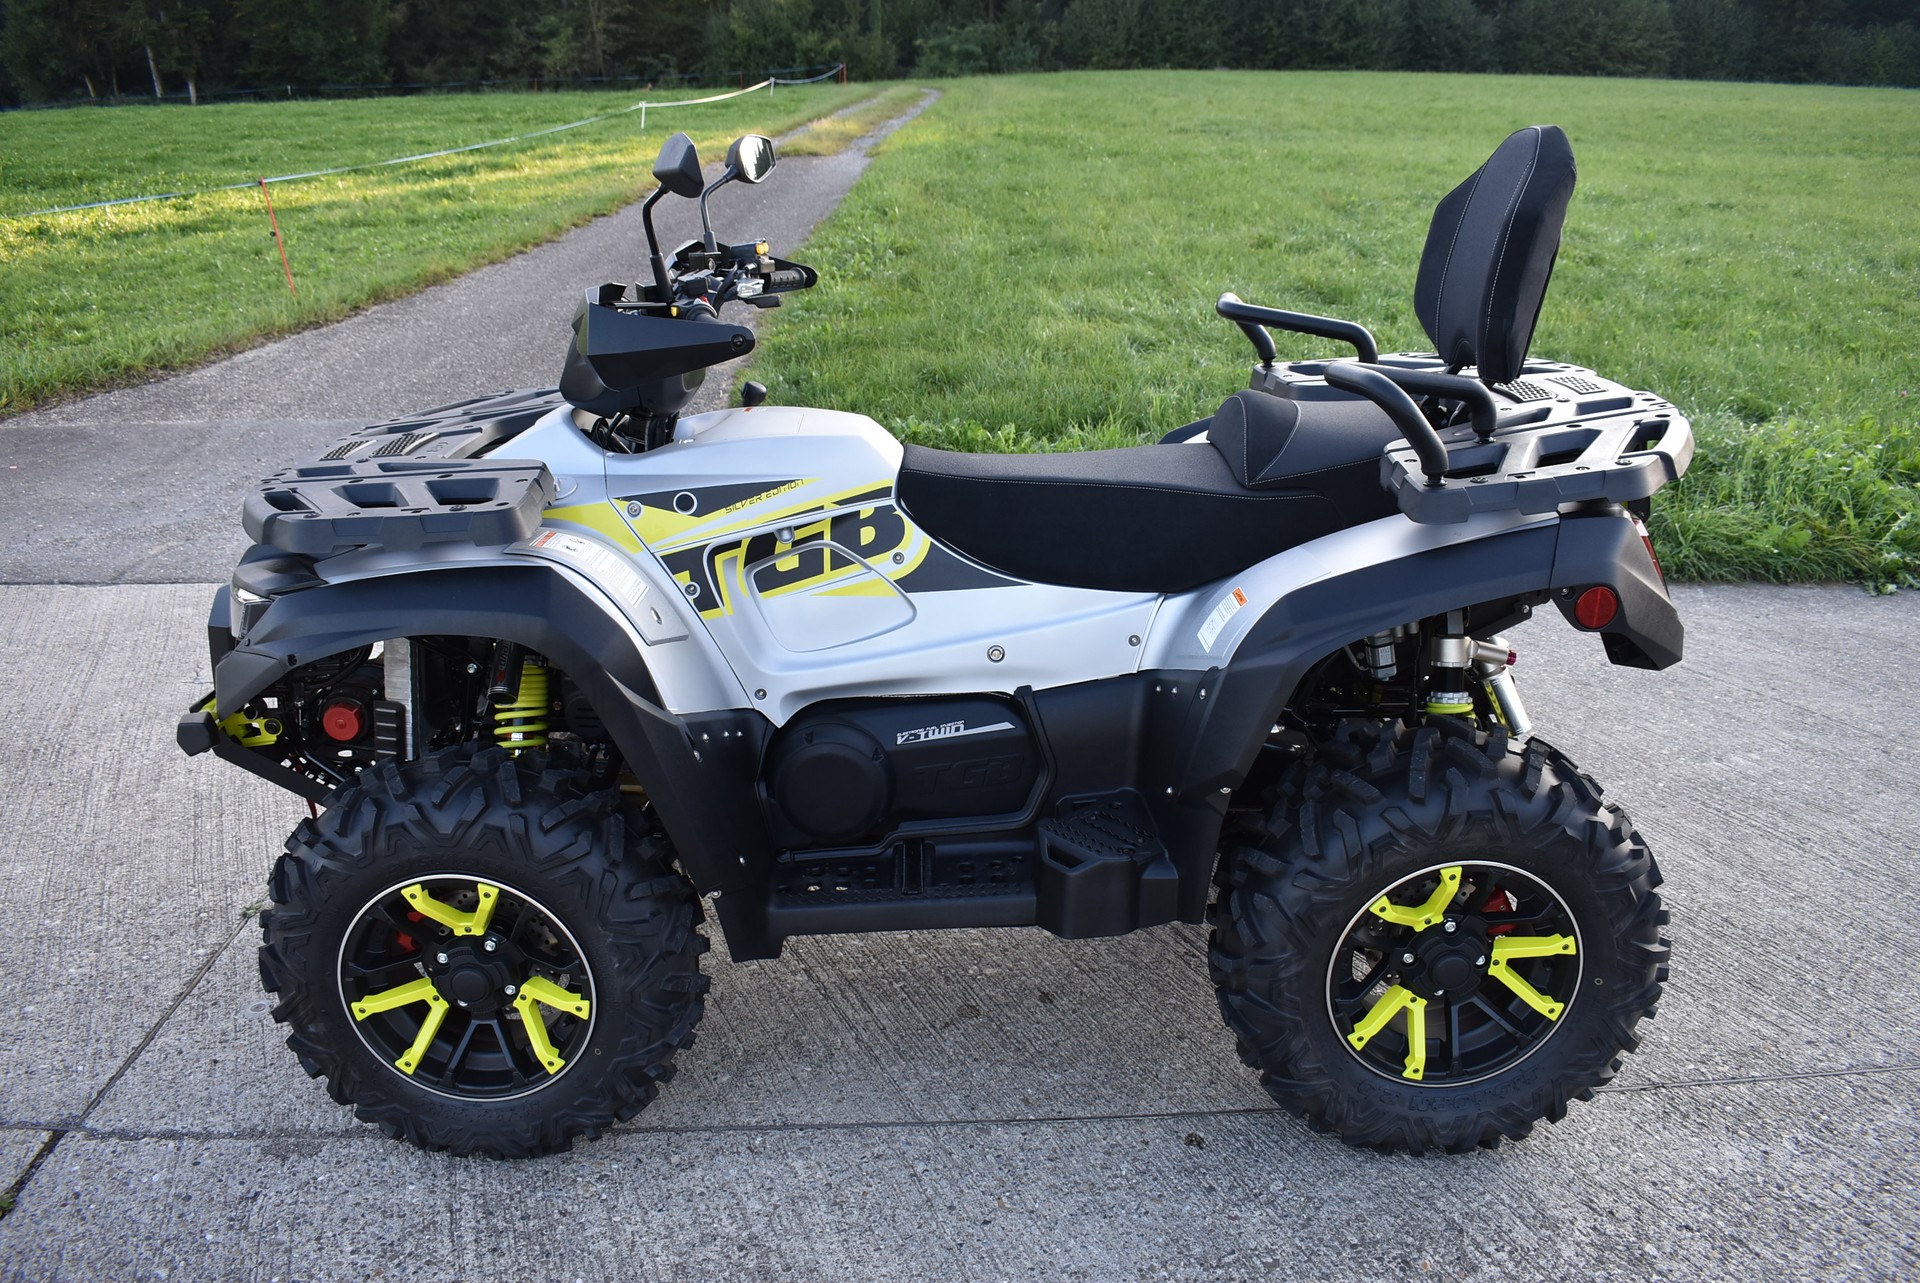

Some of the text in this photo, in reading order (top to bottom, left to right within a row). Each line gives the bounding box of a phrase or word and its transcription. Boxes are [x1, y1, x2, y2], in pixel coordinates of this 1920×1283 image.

[725, 478, 804, 514] SILVER EDITION
[658, 485, 908, 615] TGB
[911, 753, 1025, 796] TGB
